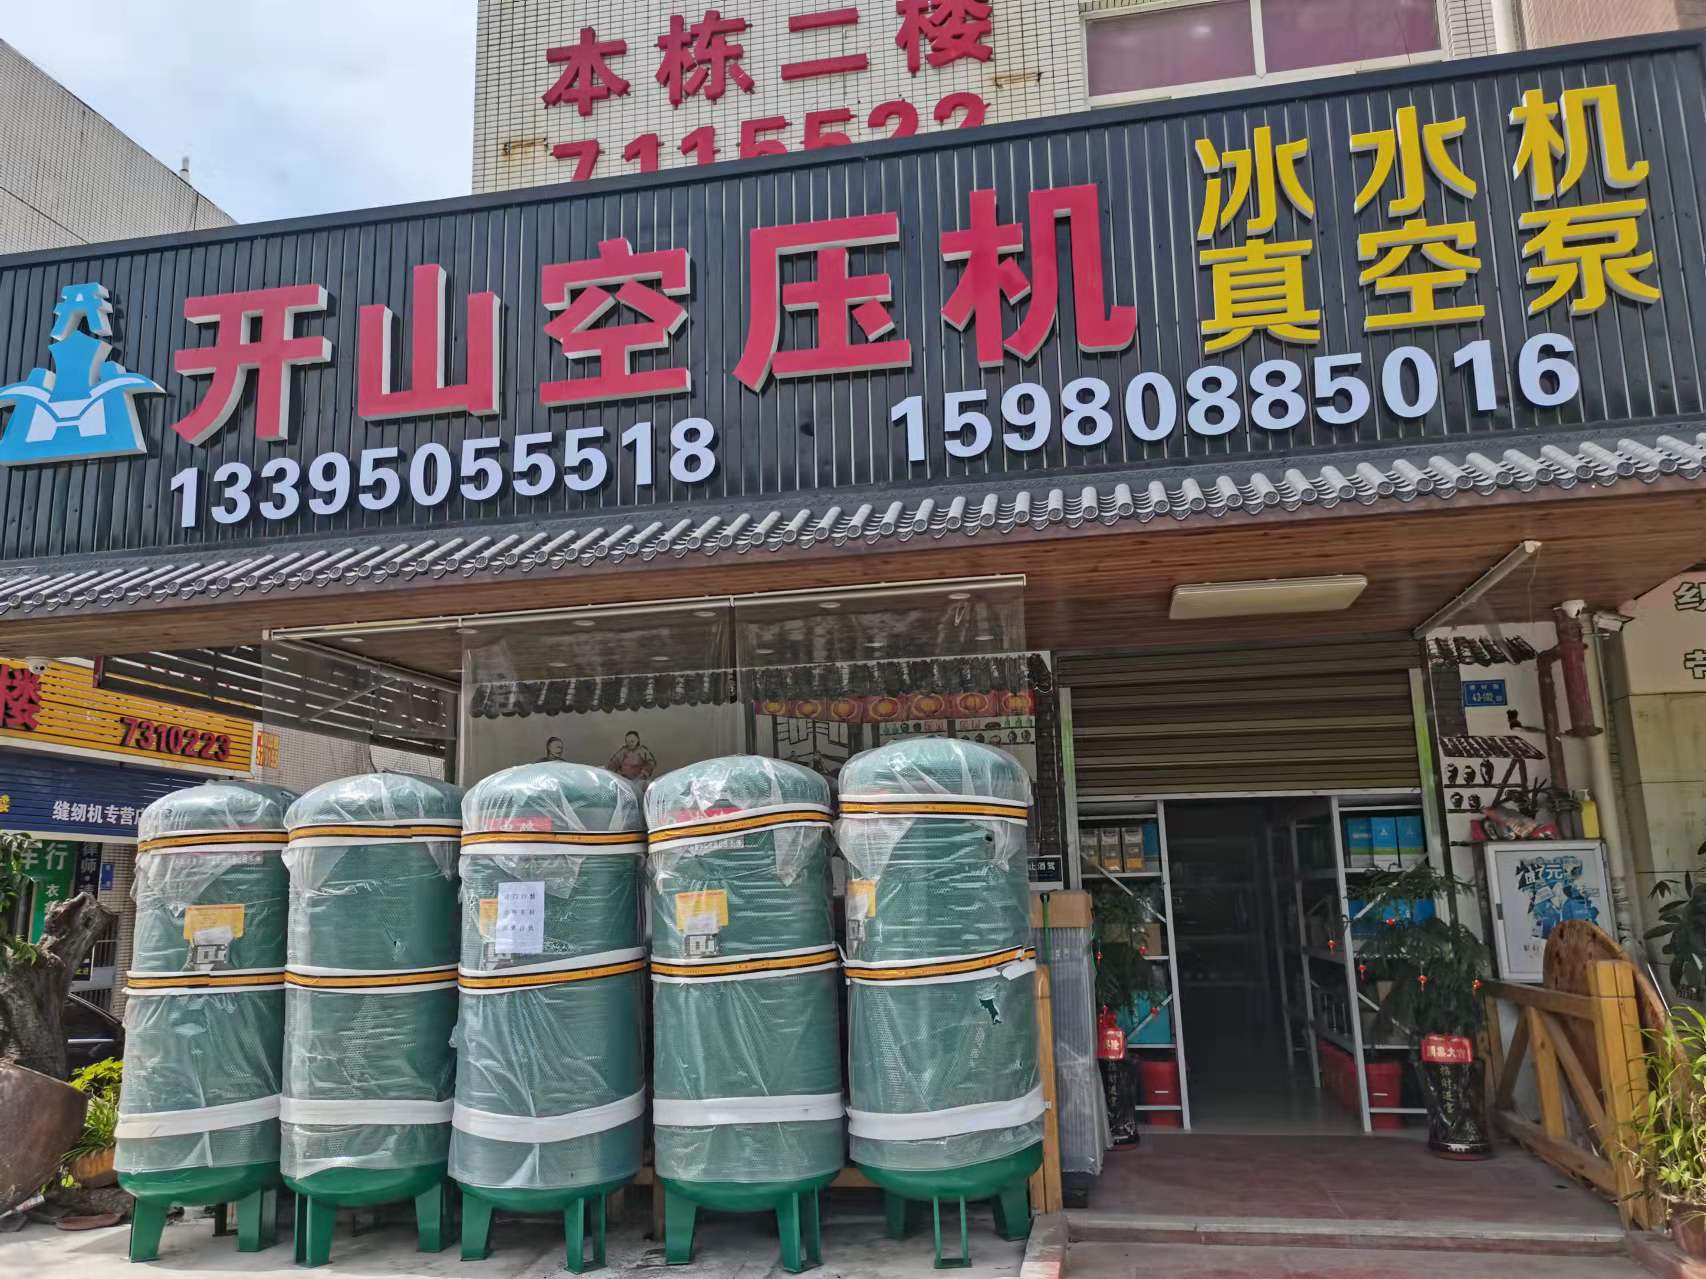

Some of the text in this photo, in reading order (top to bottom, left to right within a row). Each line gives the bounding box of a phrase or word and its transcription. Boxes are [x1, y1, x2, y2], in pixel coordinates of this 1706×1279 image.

[1195, 84, 1650, 241] 冰水机
[171, 183, 1138, 447] 开山空压机
[1200, 198, 1661, 355] 真空泵
[891, 333, 1580, 462] 15980885016
[170, 417, 716, 528] 13395055518
[120, 716, 232, 762] 7310223
